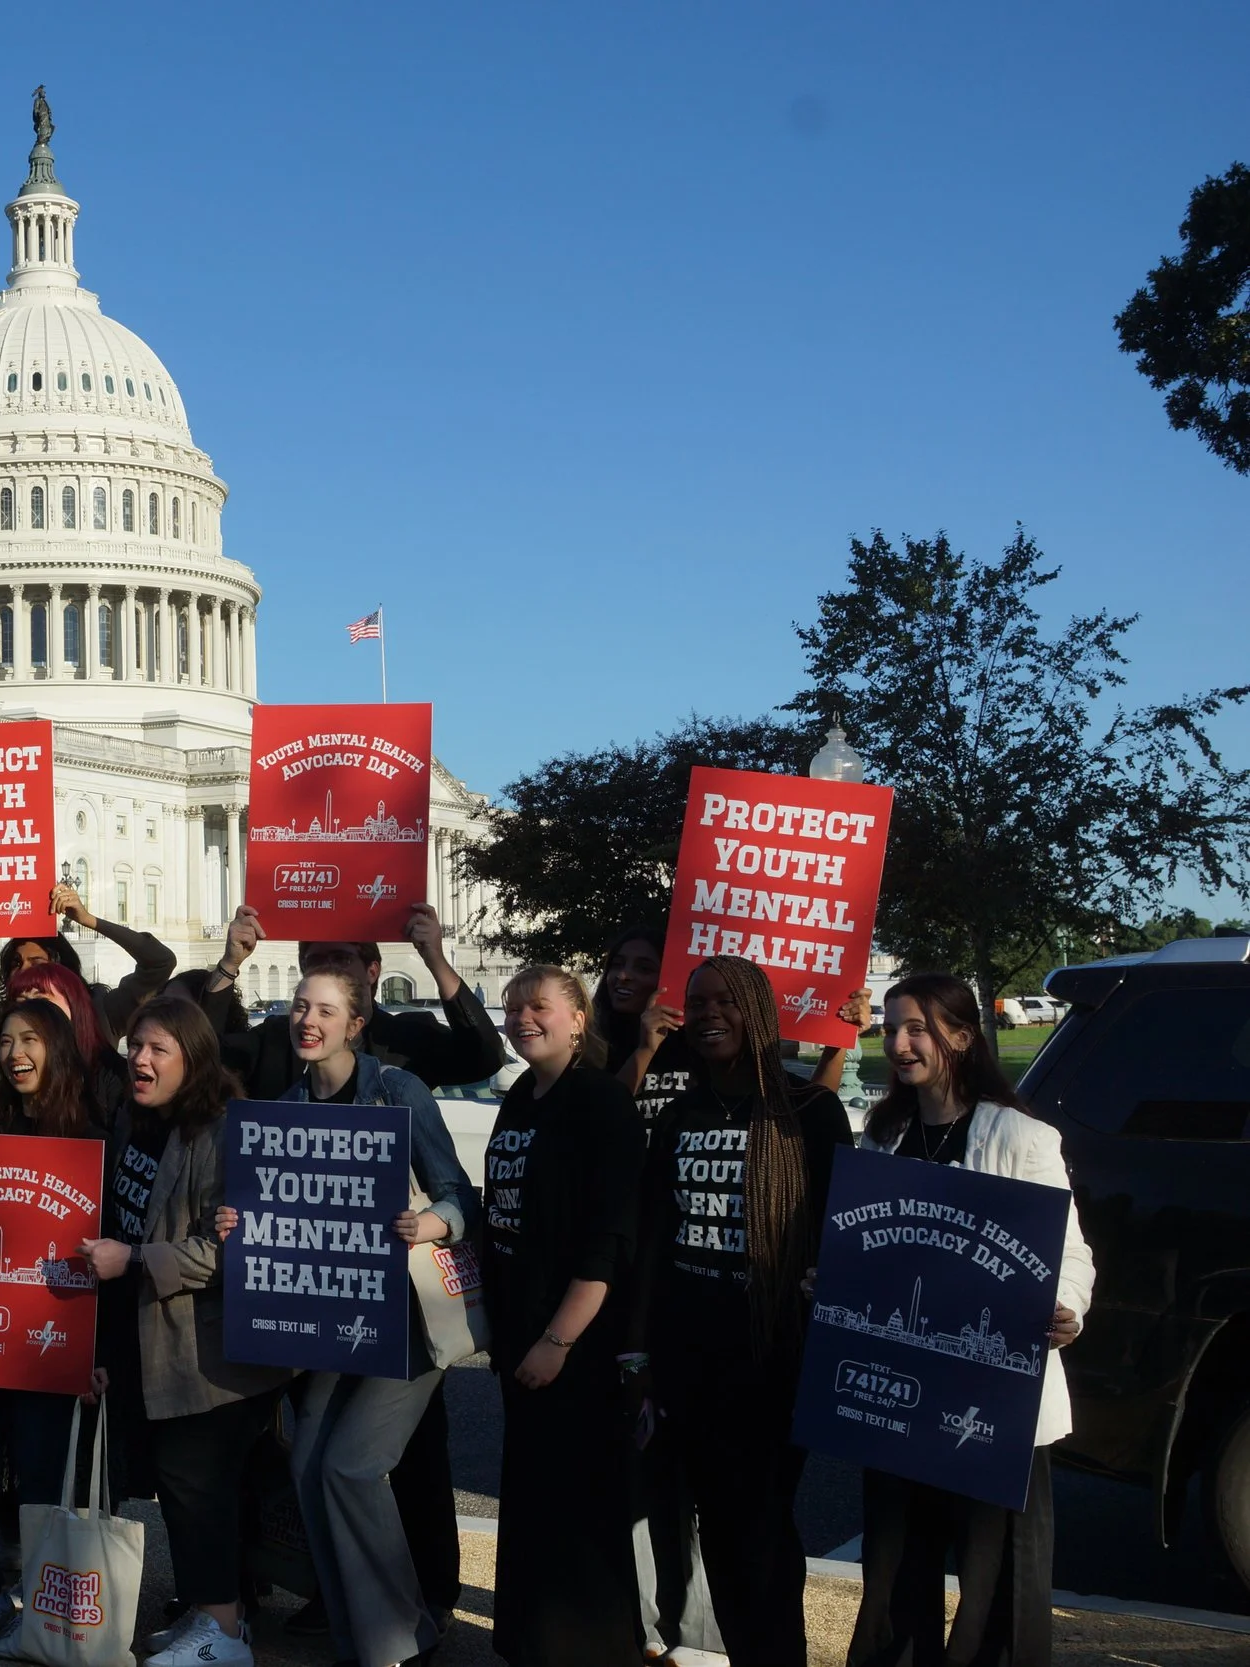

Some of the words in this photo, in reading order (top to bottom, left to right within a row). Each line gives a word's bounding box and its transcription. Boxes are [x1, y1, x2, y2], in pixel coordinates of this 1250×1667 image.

[256, 740, 304, 770] YOUTH
[308, 734, 367, 748] MENTAL
[371, 736, 425, 774] HEALTH
[281, 752, 364, 781] ADVOCACY
[366, 756, 400, 780] DAY
[700, 793, 875, 844] PROTECT
[714, 838, 846, 886] YOUTH
[281, 870, 332, 884] 741741
[358, 884, 396, 894] YOUTH
[278, 900, 298, 908] CRISIS
[300, 900, 317, 908] TEXT
[318, 900, 332, 908] LINE
[691, 879, 854, 932] MENTAL
[687, 922, 844, 976] HEALTH
[783, 994, 828, 1010] YOUTH
[240, 1121, 396, 1162] PROTECT
[675, 1129, 748, 1154] PROT
[677, 1157, 744, 1183] YOUT
[42, 1173, 96, 1216] HEALTH
[255, 1166, 375, 1208] YOUTH
[38, 1194, 71, 1220] DAY
[674, 1189, 744, 1218] ENT
[242, 1210, 390, 1255] MENTAL
[675, 1220, 746, 1252] EALT
[832, 1202, 892, 1232] YOUTH
[898, 1199, 977, 1231] MENTAL
[980, 1219, 1052, 1282] HEALTH
[862, 1227, 970, 1256] ADVOCACY
[972, 1243, 1016, 1282] DAY
[244, 1256, 385, 1301] HEALTH
[27, 1329, 66, 1341] YOUTH
[252, 1318, 276, 1330] CRISIS
[278, 1321, 298, 1332] TEXT
[300, 1322, 317, 1334] LINE
[336, 1324, 377, 1338] YOUTH
[870, 1362, 891, 1374] TEXT
[846, 1368, 911, 1400] 741741
[854, 1390, 874, 1402] FREE,
[876, 1396, 896, 1408] 24/7
[837, 1405, 863, 1422] CRISIS
[865, 1412, 886, 1428] TEXT
[888, 1419, 906, 1434] LINE
[942, 1412, 994, 1436] YOUTH
[46, 1569, 95, 1592] metal
[48, 1580, 90, 1606] helth
[38, 1595, 98, 1620] maters
